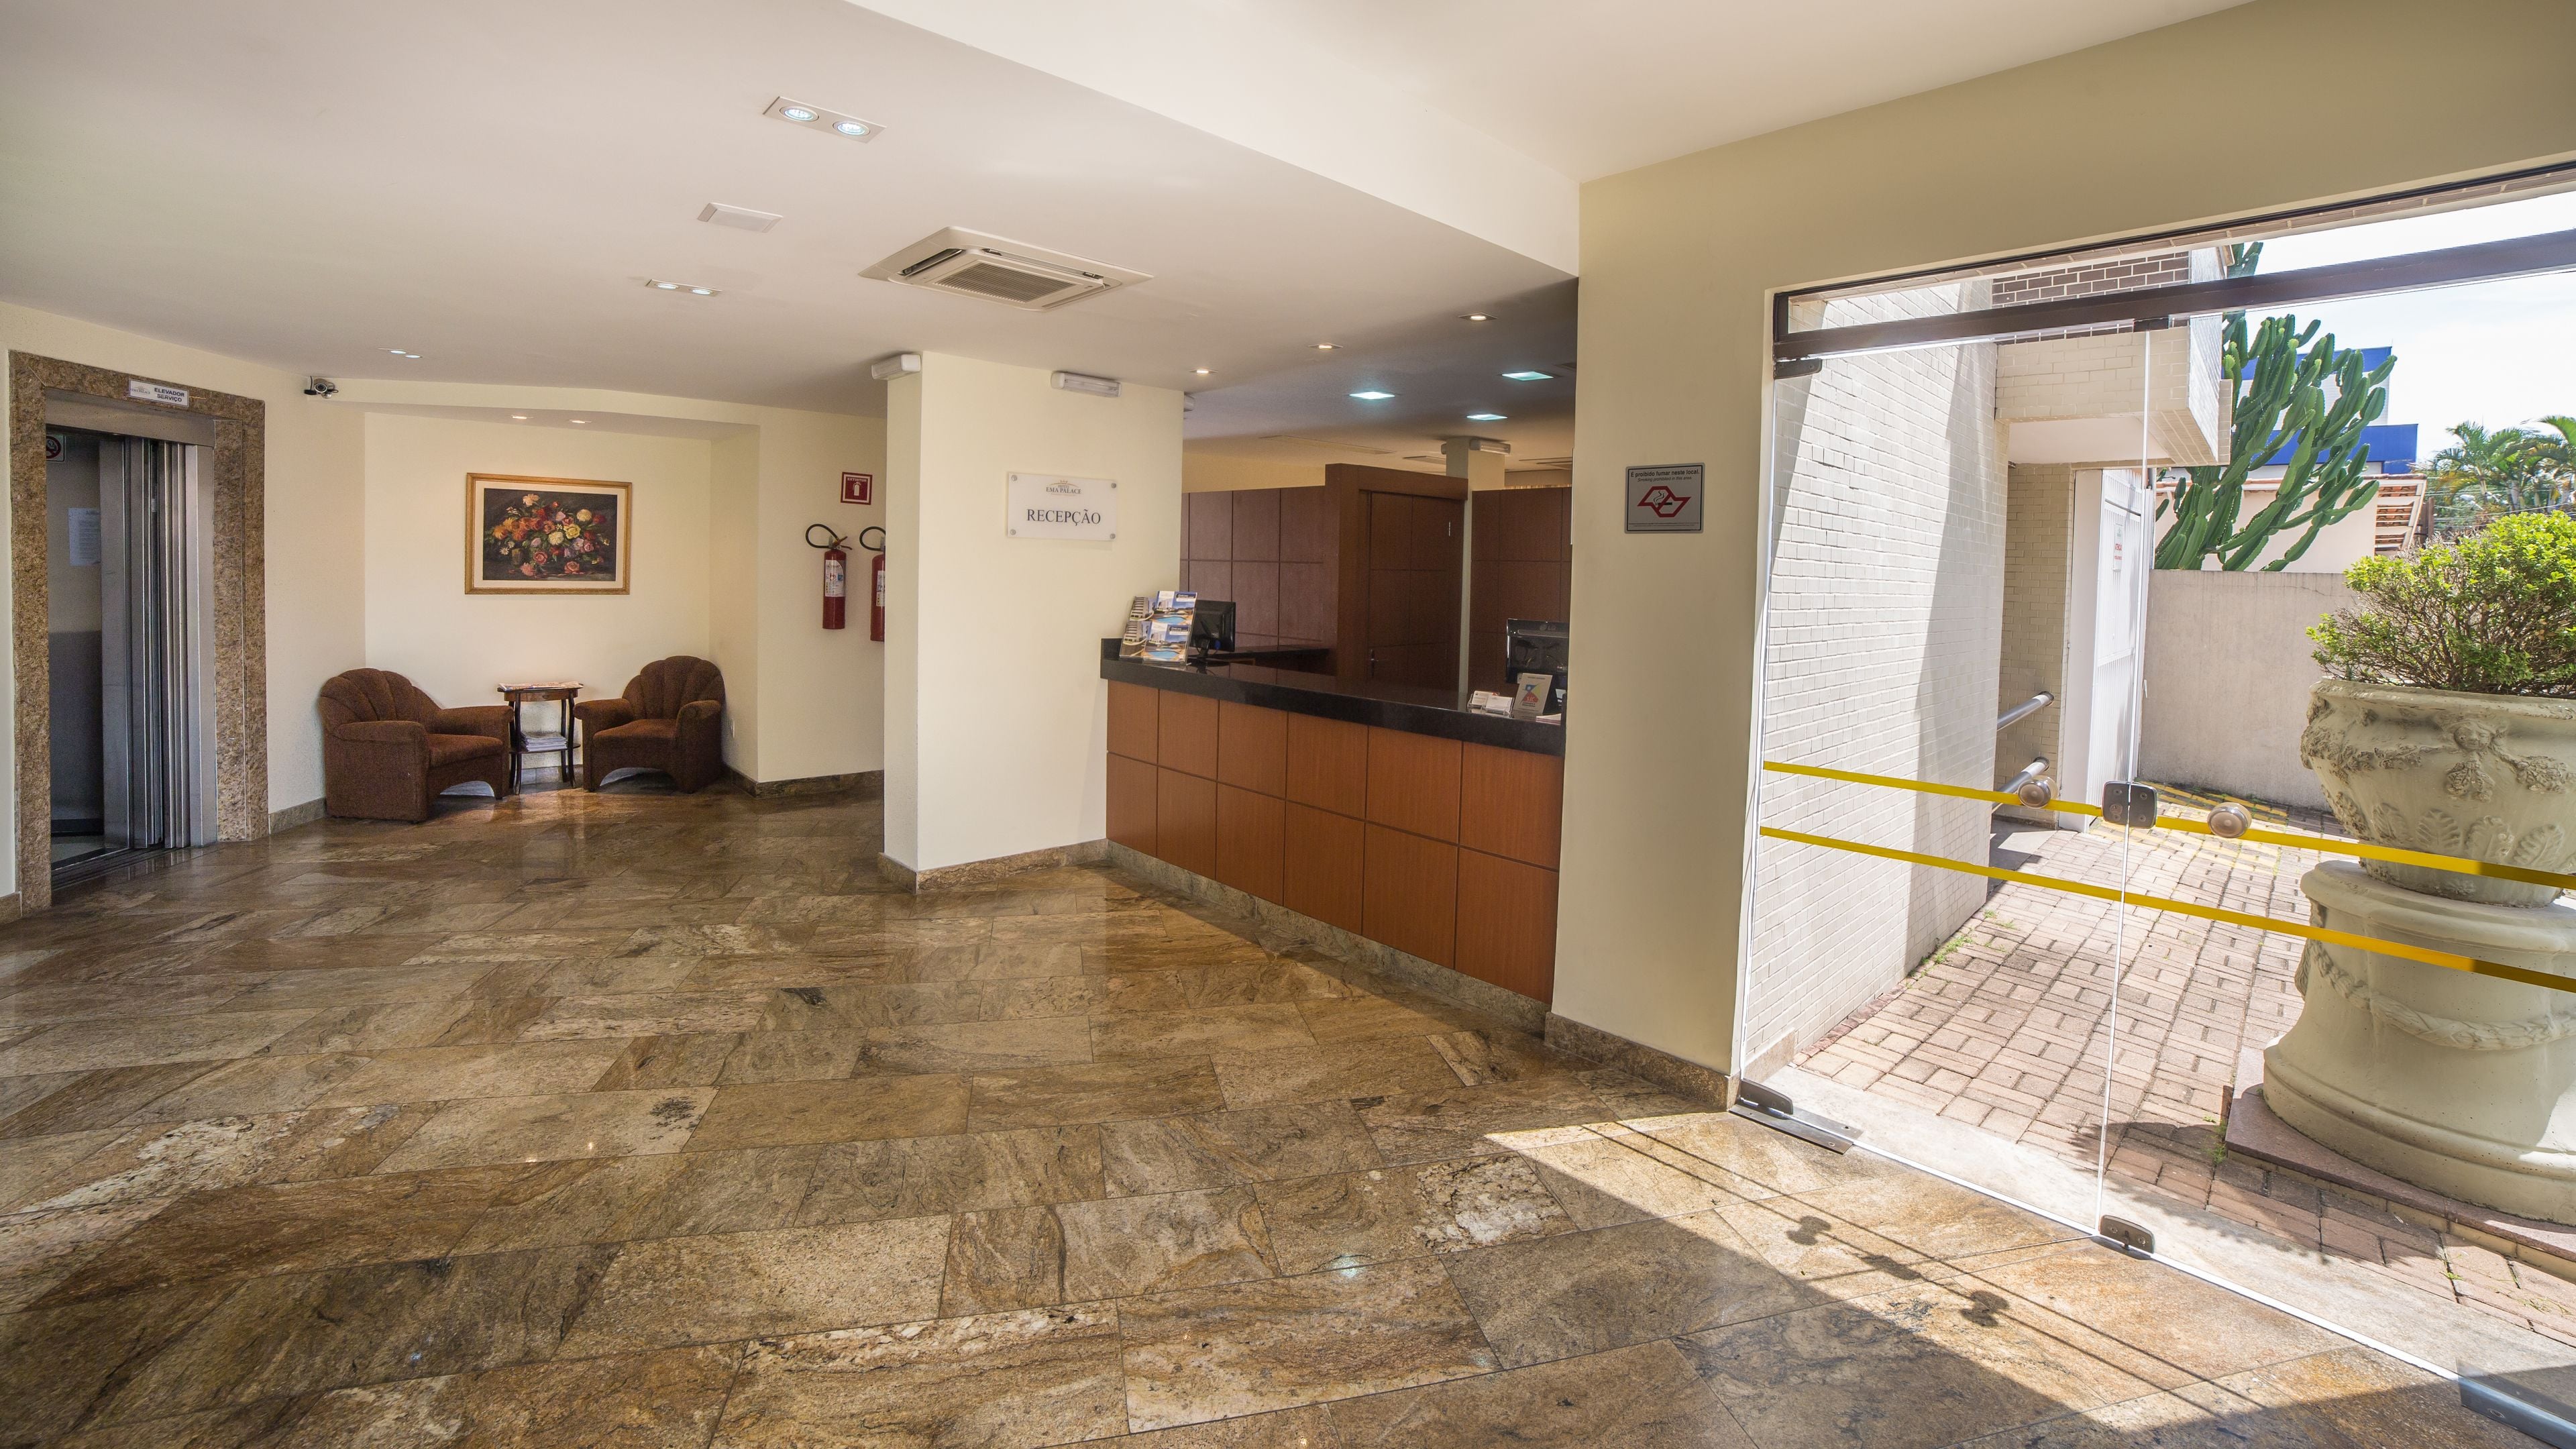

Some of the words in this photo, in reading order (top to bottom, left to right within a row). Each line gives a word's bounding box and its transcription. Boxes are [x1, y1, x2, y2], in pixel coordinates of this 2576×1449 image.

[154, 388, 184, 397] ELEVADOR
[157, 394, 182, 402] SERVIÇO
[1026, 508, 1101, 526] RECEPÇÃO
